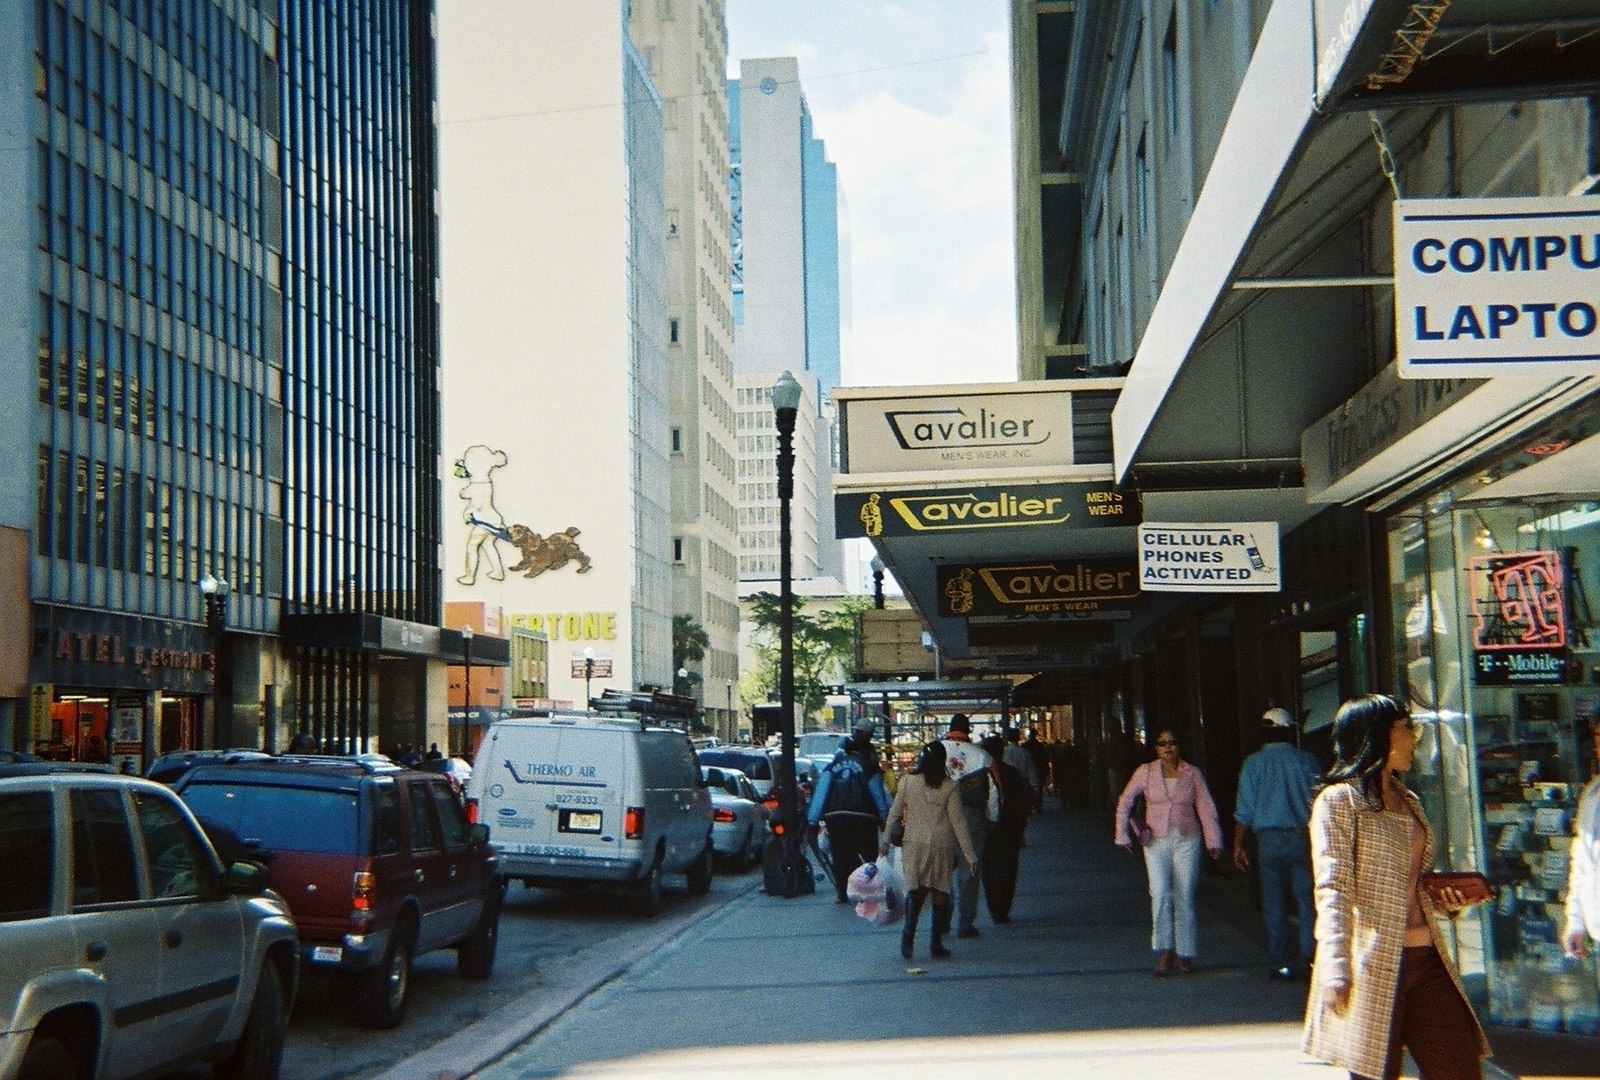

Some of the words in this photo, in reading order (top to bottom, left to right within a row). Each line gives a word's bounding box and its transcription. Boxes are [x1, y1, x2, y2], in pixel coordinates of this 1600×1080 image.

[1412, 234, 1600, 274] COMPU
[1414, 302, 1598, 341] LAPTO
[1087, 491, 1123, 503] MEN'S
[1089, 504, 1123, 516] WEAR
[1143, 533, 1245, 546] CELLULAR
[1143, 550, 1224, 563] PHONES
[1144, 567, 1252, 580] ACTIVATED
[1025, 603, 1059, 612] MEN'S
[1064, 602, 1098, 611] WEAR
[527, 763, 573, 777] THERMO
[579, 766, 597, 778] AIR
